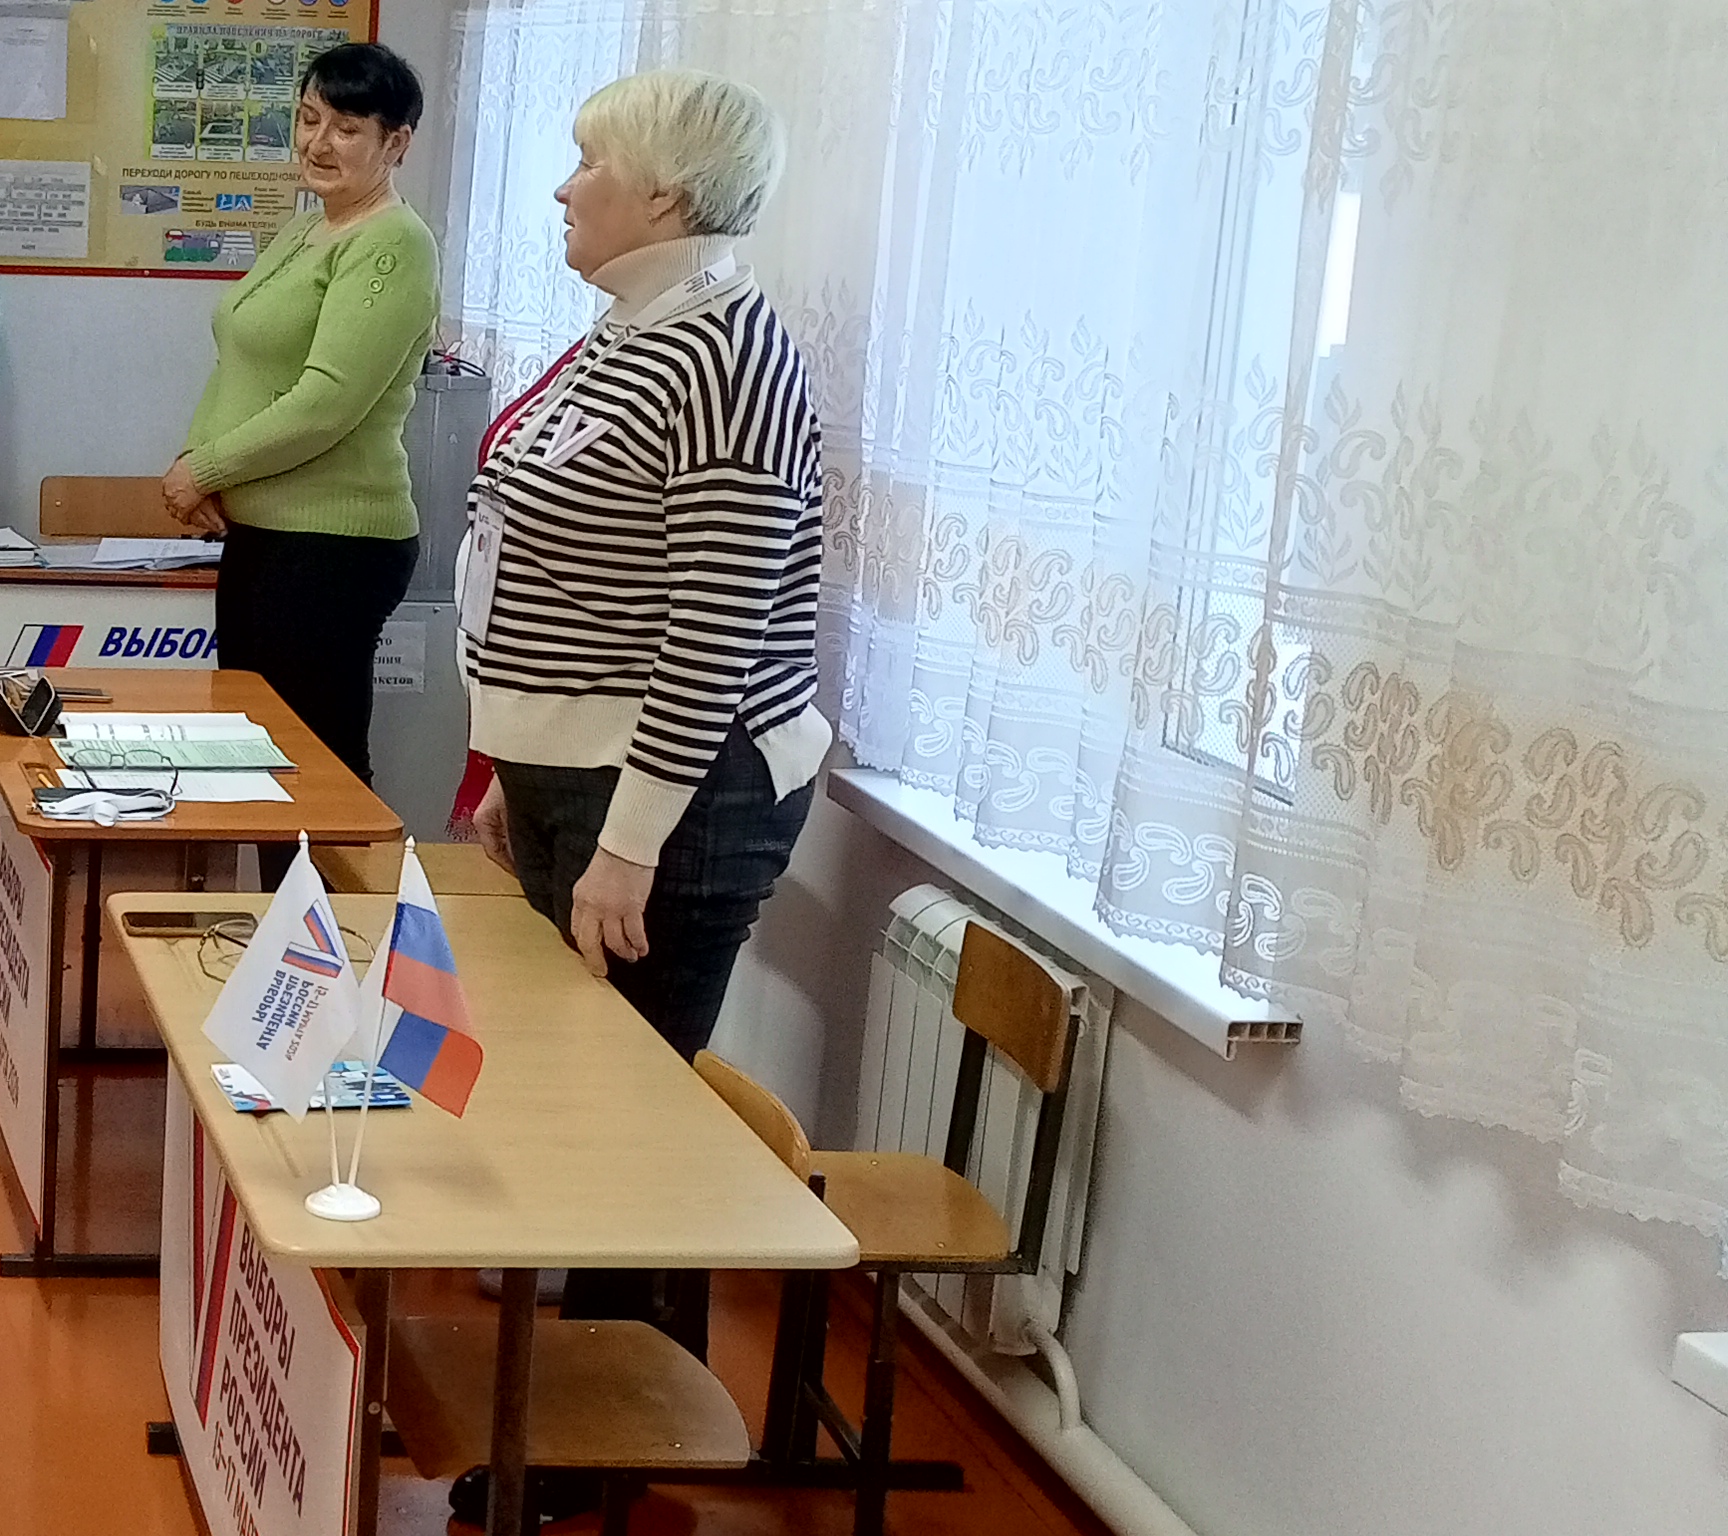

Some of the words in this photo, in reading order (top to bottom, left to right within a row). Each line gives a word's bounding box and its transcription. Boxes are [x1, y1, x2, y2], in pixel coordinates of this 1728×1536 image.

[122, 167, 172, 179] ПЕРЕХОДИ
[174, 168, 211, 181] ДОРОГУ
[214, 171, 227, 181] ПО
[239, 1221, 295, 1378] ВЫБОРЫ
[220, 1354, 267, 1509] РОССИИ
[229, 1288, 306, 1517] ПРЕЗИДЕНТА
